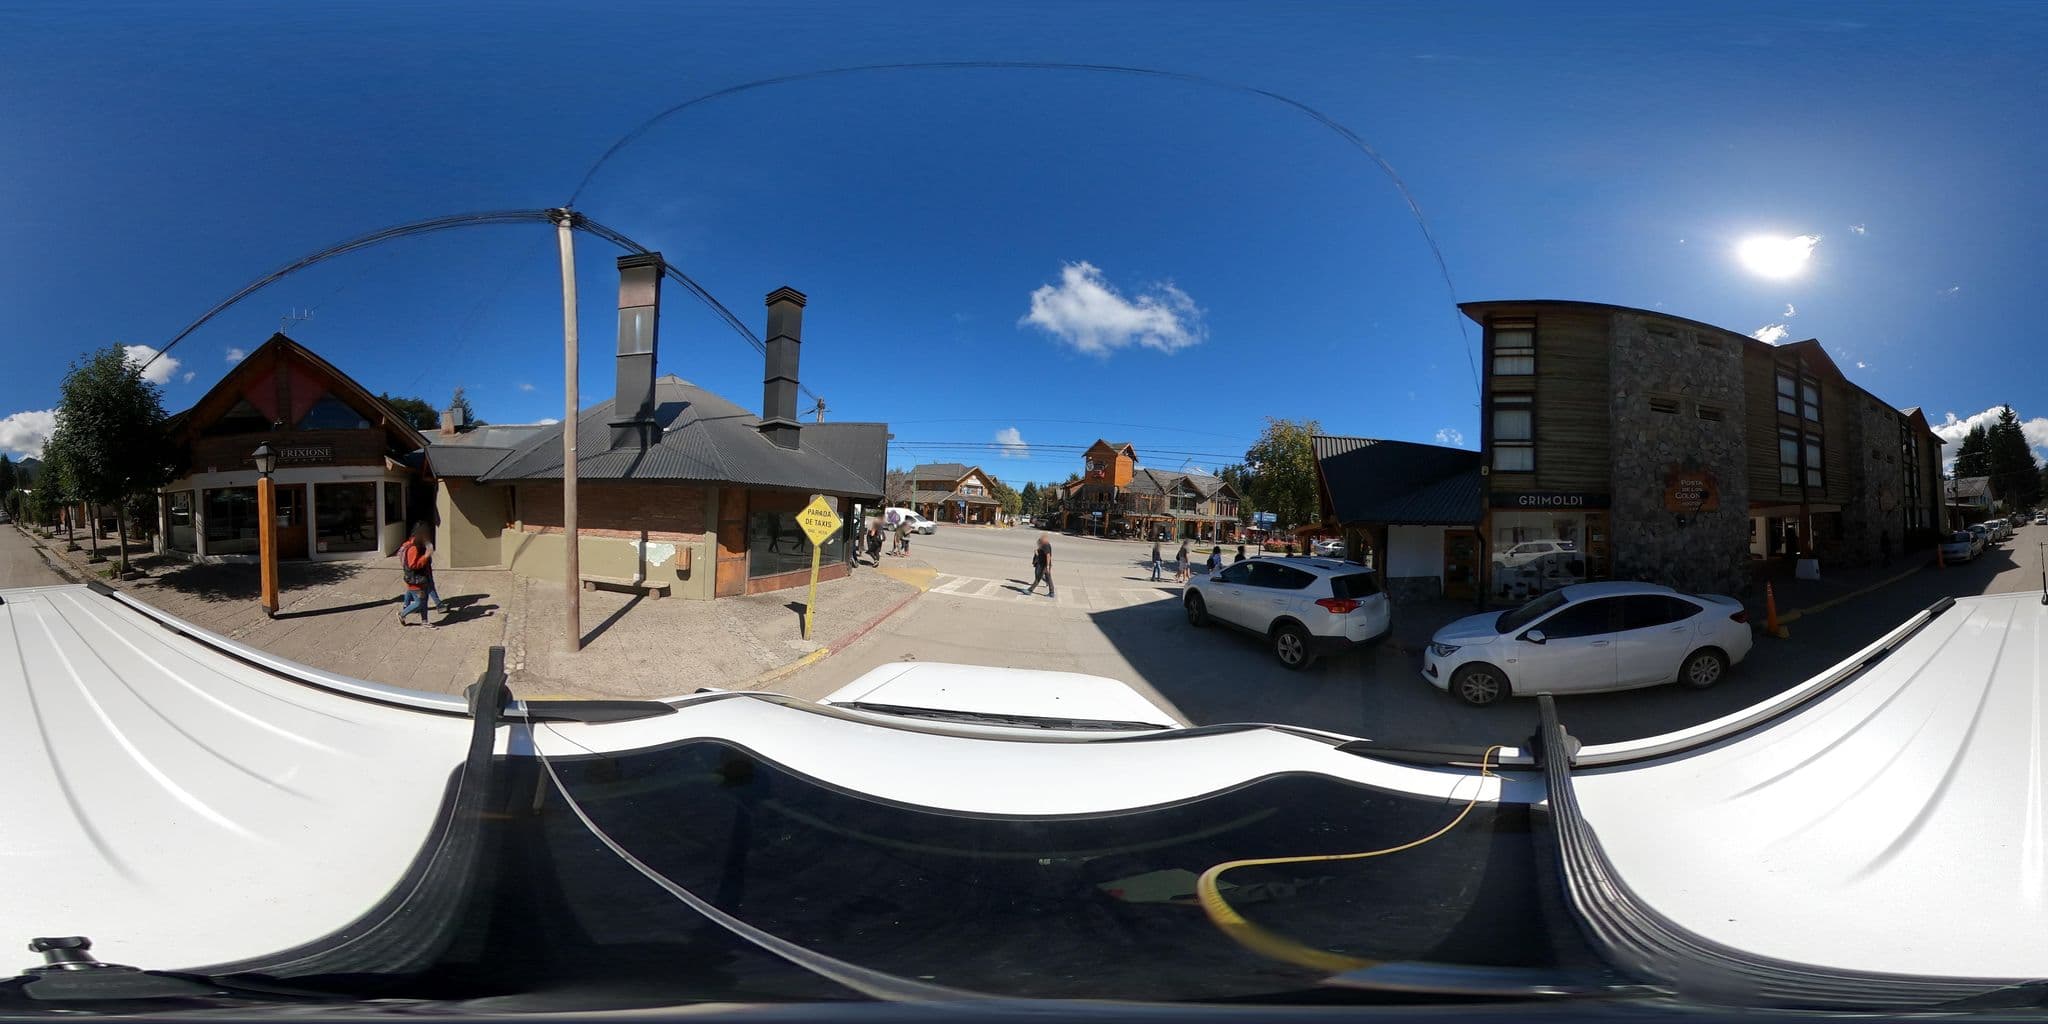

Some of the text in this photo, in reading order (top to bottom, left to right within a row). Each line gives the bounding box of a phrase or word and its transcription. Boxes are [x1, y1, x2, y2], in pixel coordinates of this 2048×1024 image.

[280, 447, 331, 458] FRIXIONE
[1518, 495, 1583, 506] GRIMOLDI
[807, 508, 831, 518] PARADA
[805, 518, 832, 528] DE TAXIS
